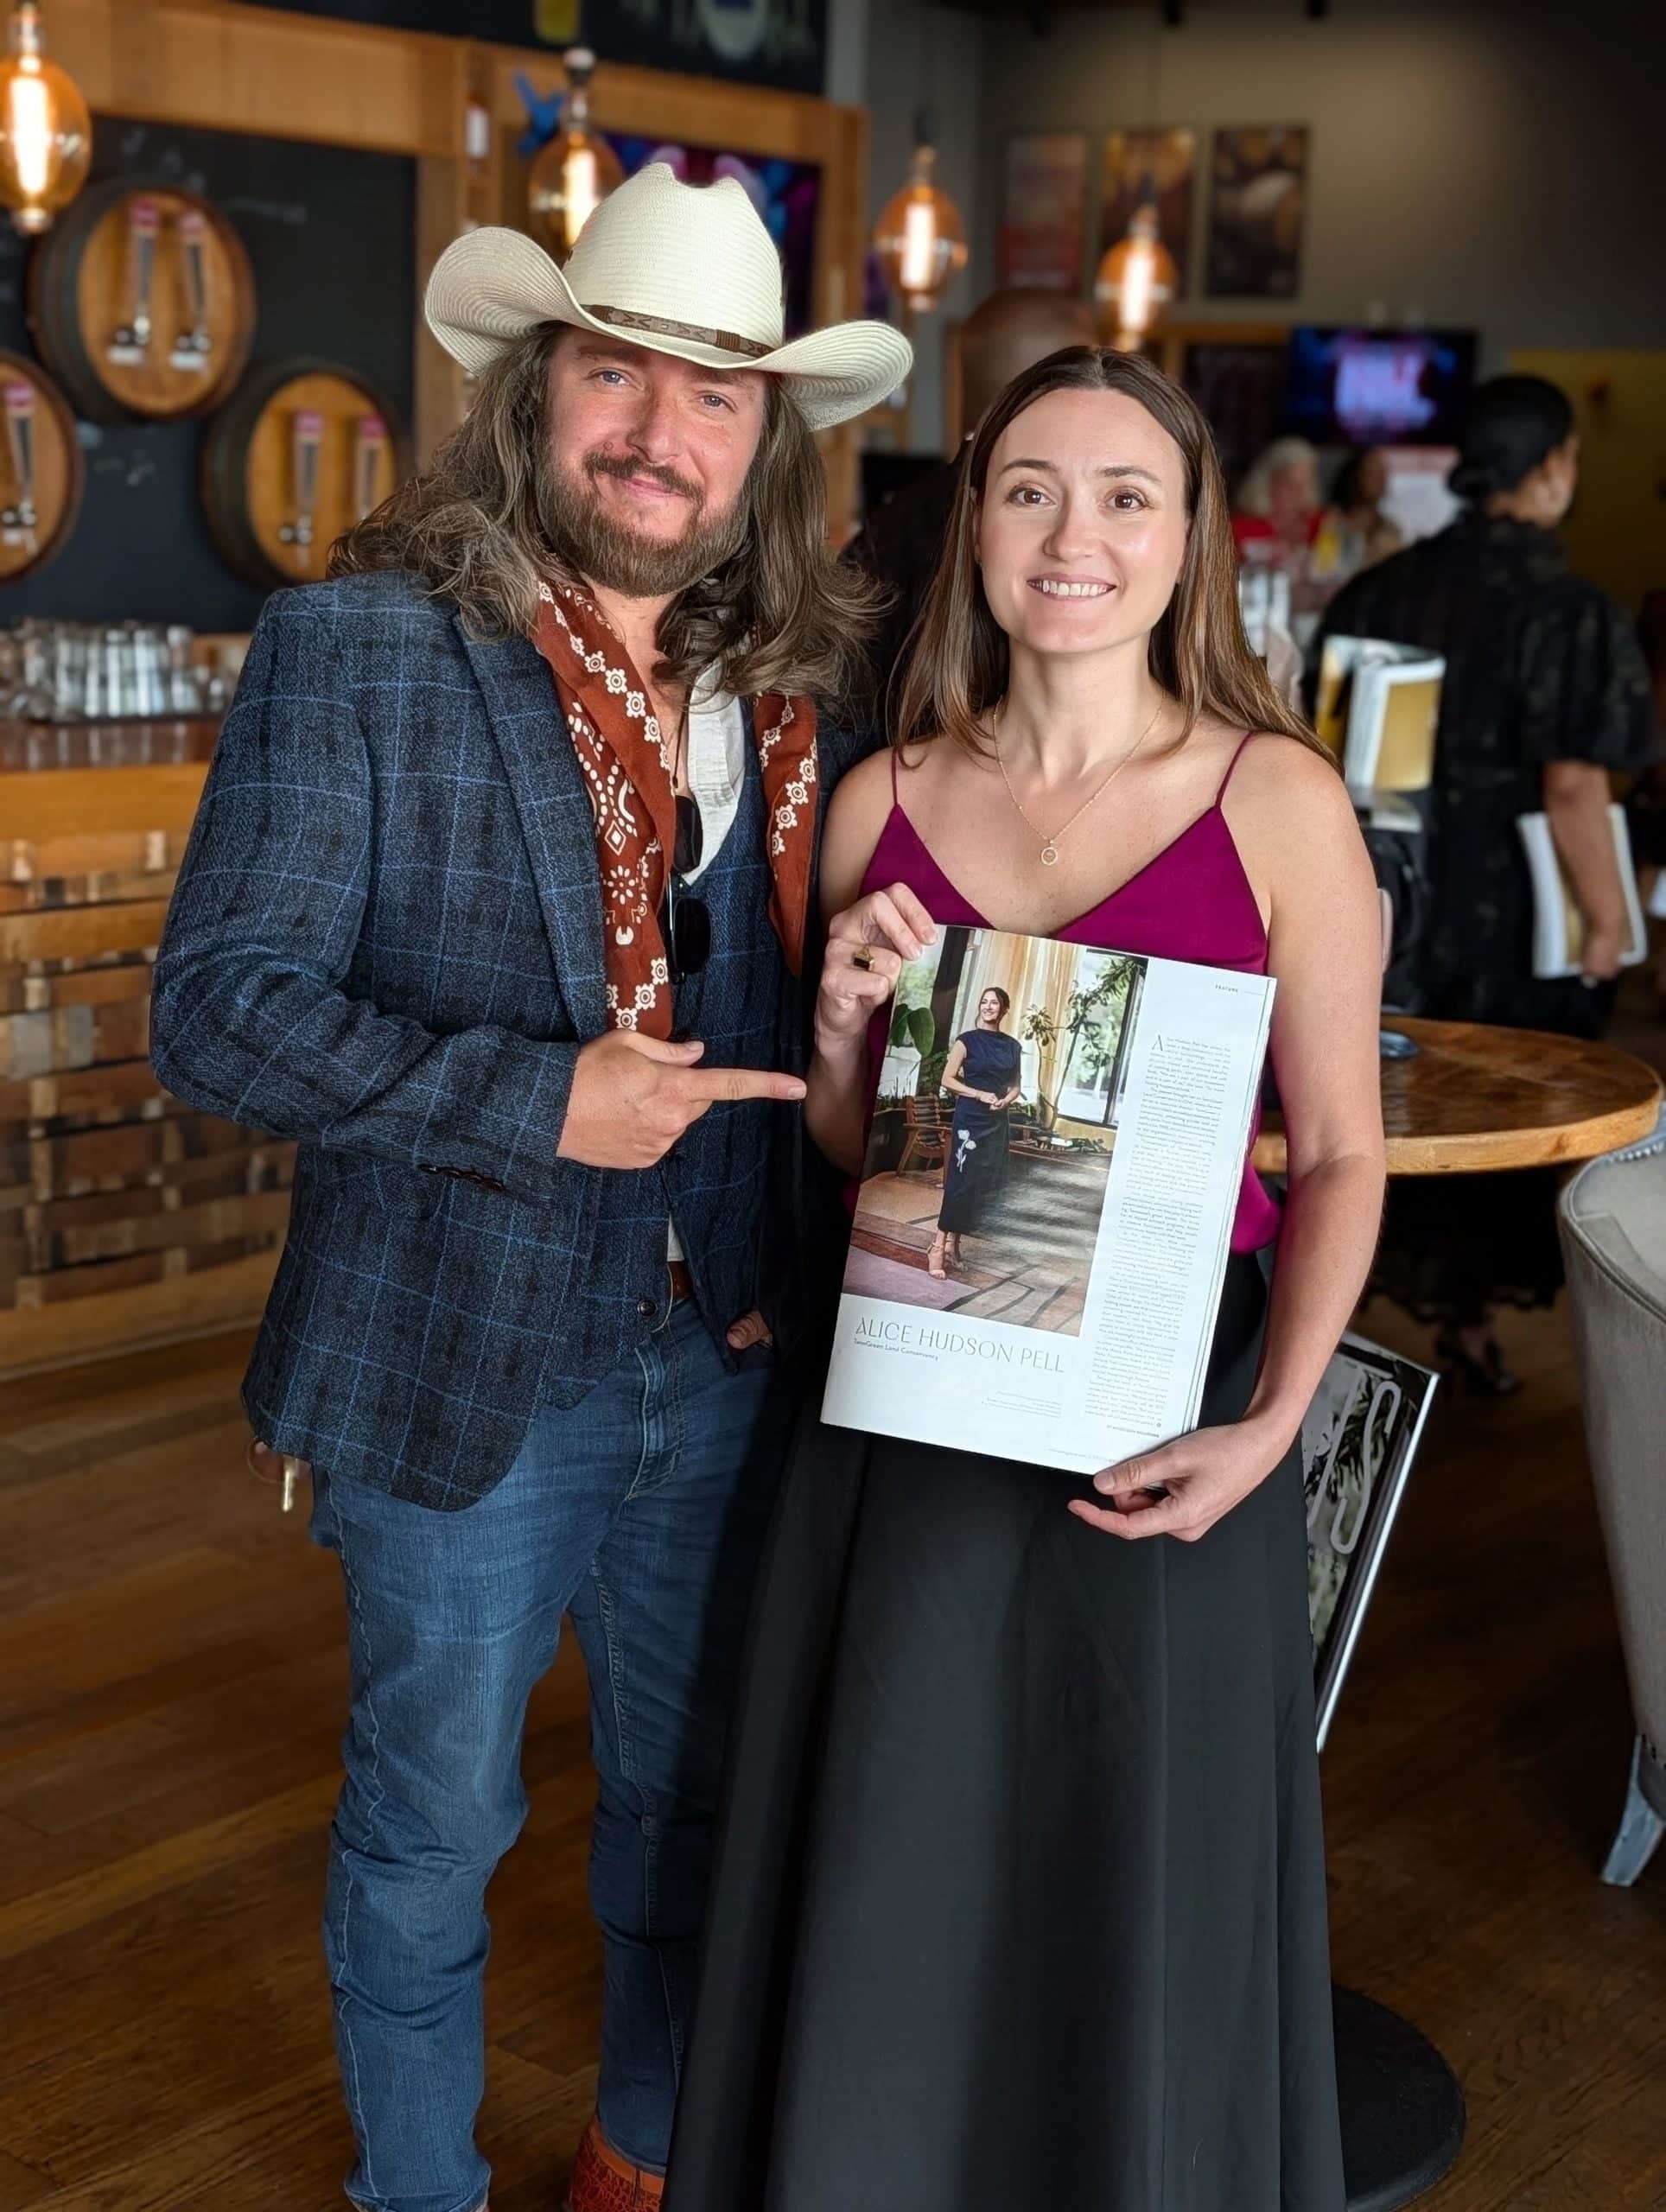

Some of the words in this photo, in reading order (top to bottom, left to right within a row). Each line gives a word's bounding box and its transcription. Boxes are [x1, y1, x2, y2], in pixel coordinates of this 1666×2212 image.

[855, 1316, 912, 1344] ALICE
[919, 1327, 1014, 1363] HUDSON
[1020, 1347, 1065, 1374] PELL
